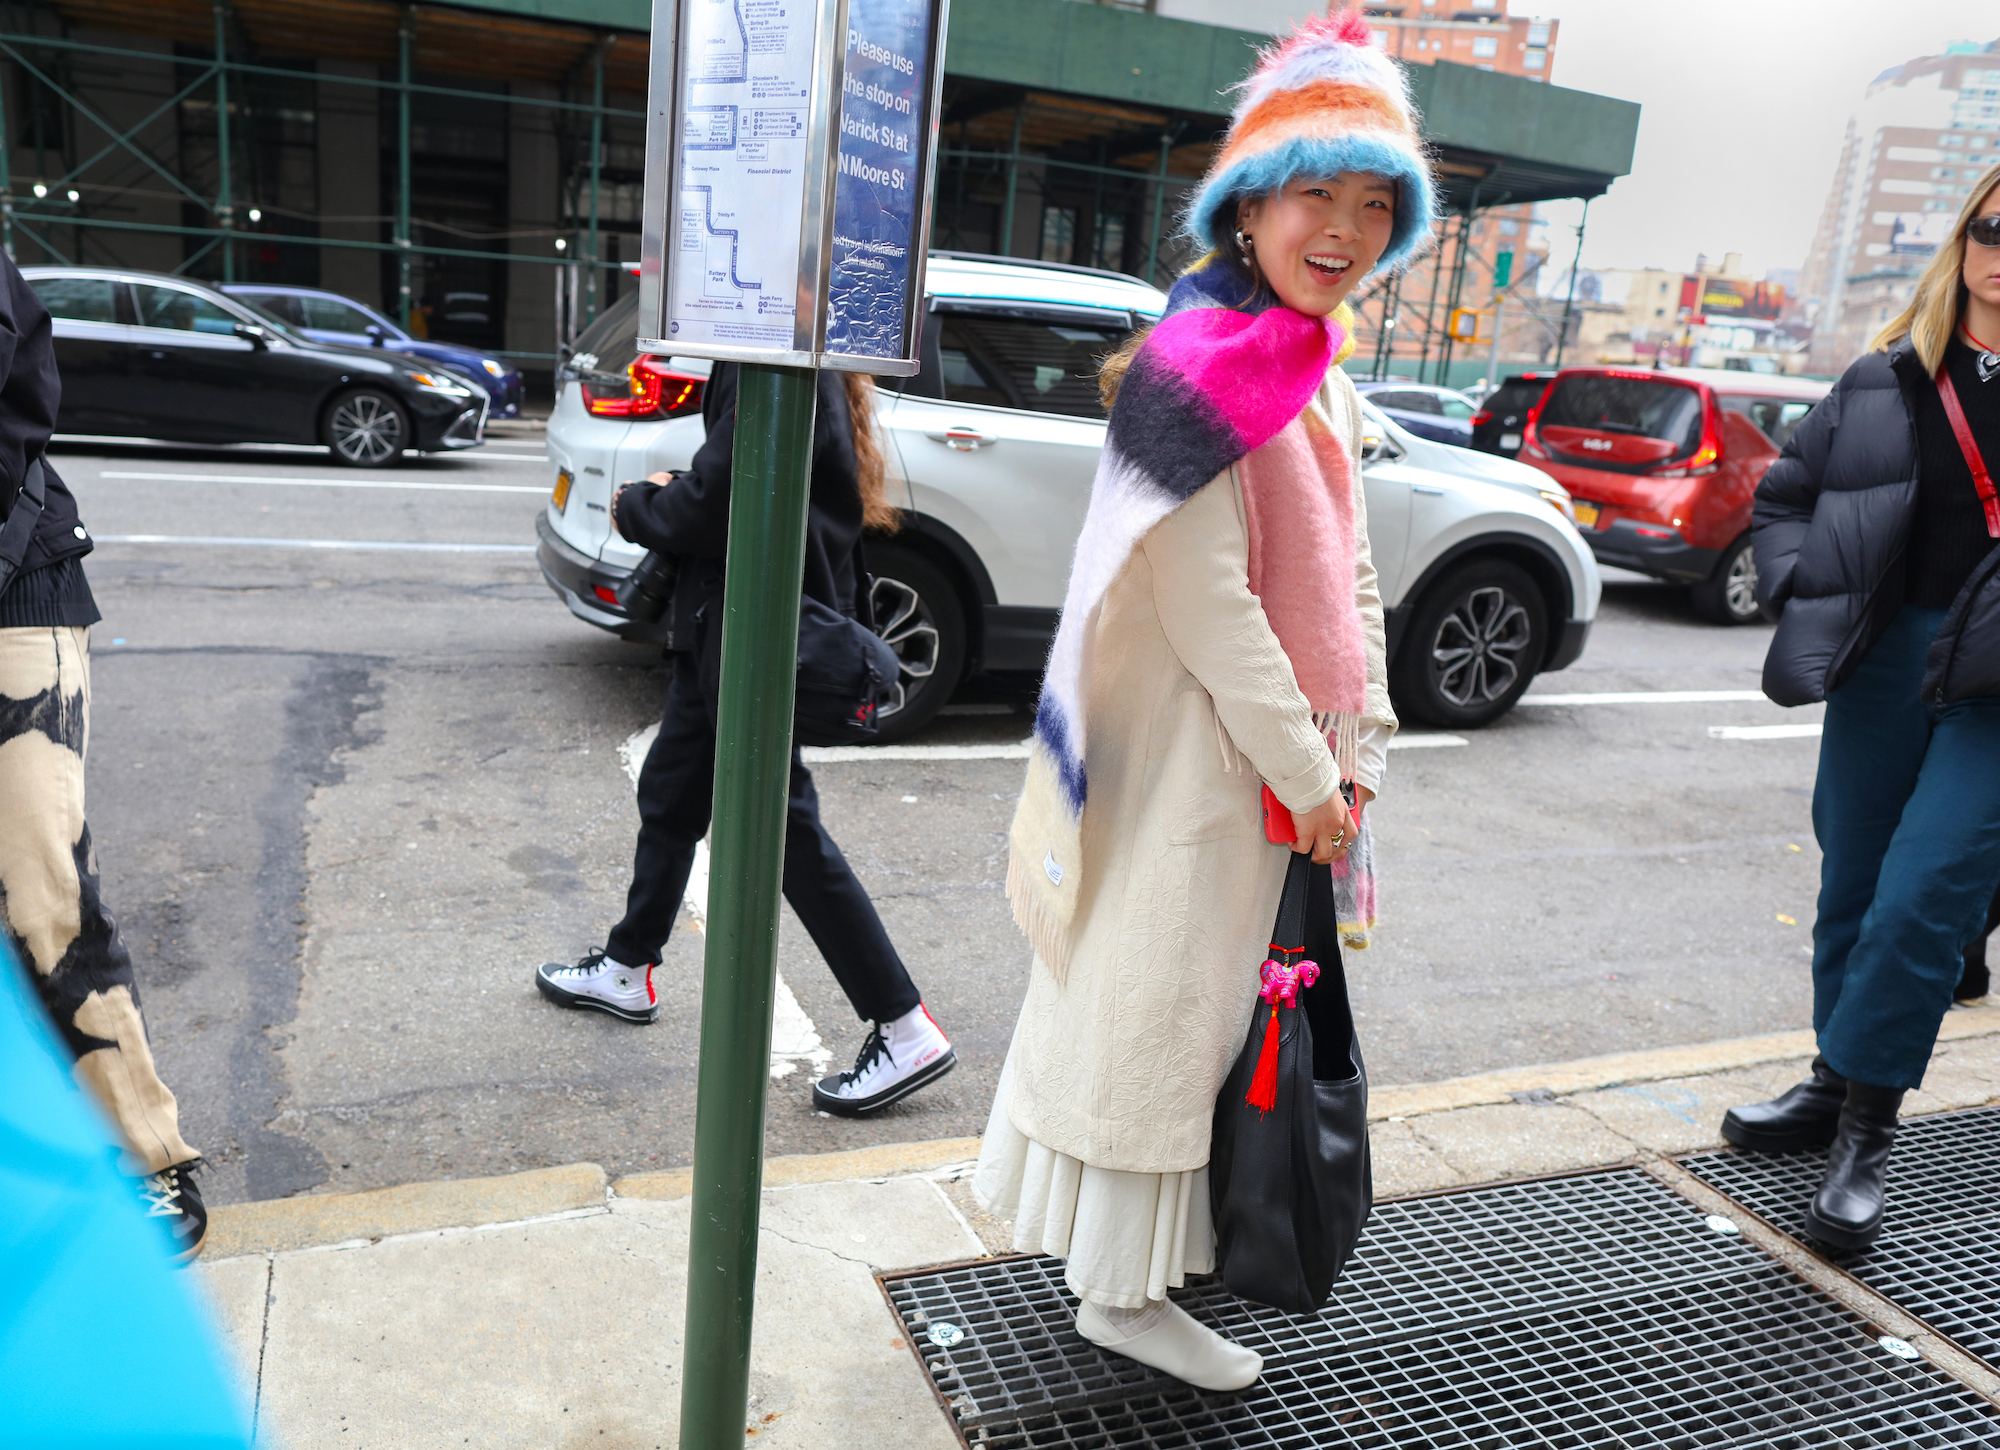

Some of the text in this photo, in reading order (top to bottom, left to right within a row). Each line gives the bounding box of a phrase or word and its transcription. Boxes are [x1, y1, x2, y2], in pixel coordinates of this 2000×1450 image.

[848, 29, 914, 76] Please use
[843, 71, 910, 115] the stop on
[841, 110, 908, 153] Varick St at
[838, 152, 905, 191] N Moore St
[832, 235, 845, 246] eed
[845, 236, 864, 250] travel
